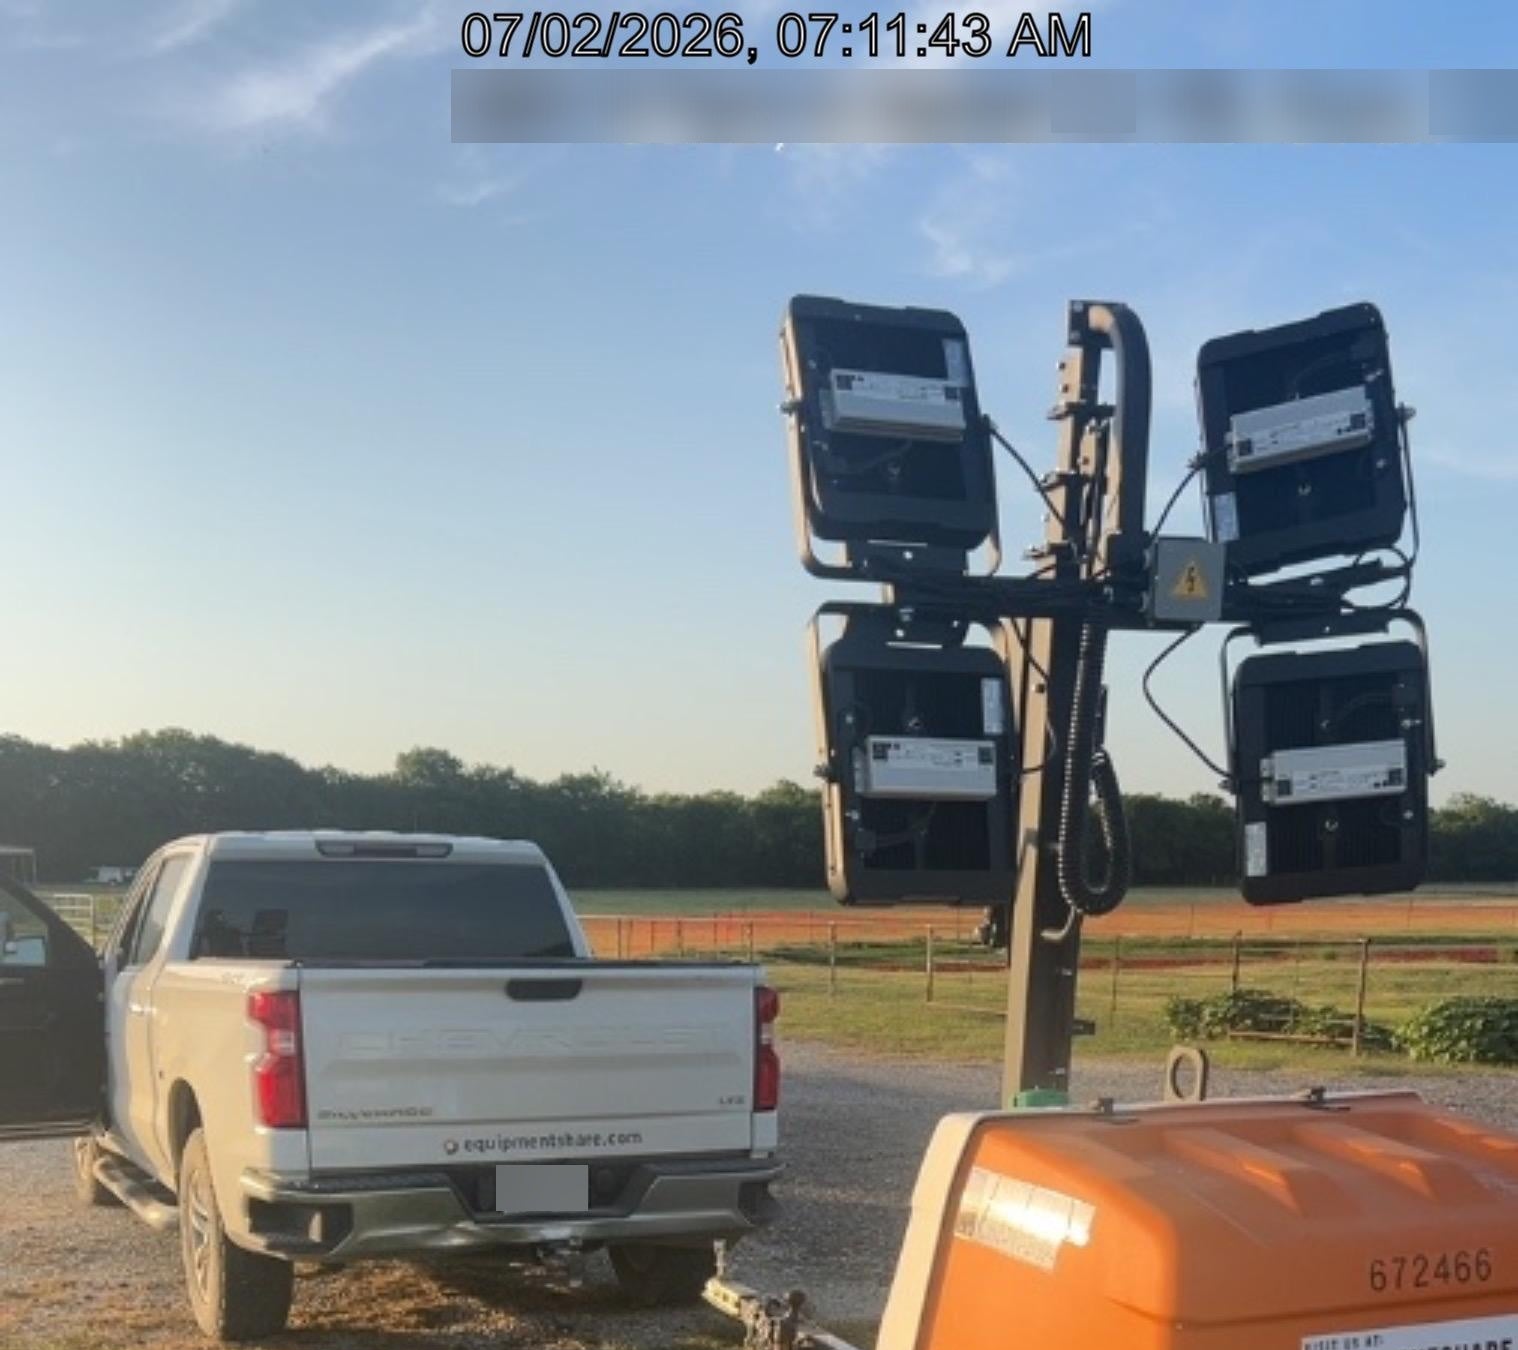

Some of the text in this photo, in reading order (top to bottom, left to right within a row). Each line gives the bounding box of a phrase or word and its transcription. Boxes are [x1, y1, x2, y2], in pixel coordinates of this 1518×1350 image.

[464, 1131, 643, 1153] equipmentshare.com
[1370, 1248, 1492, 1292] 672466
[1344, 1337, 1360, 1350] US
